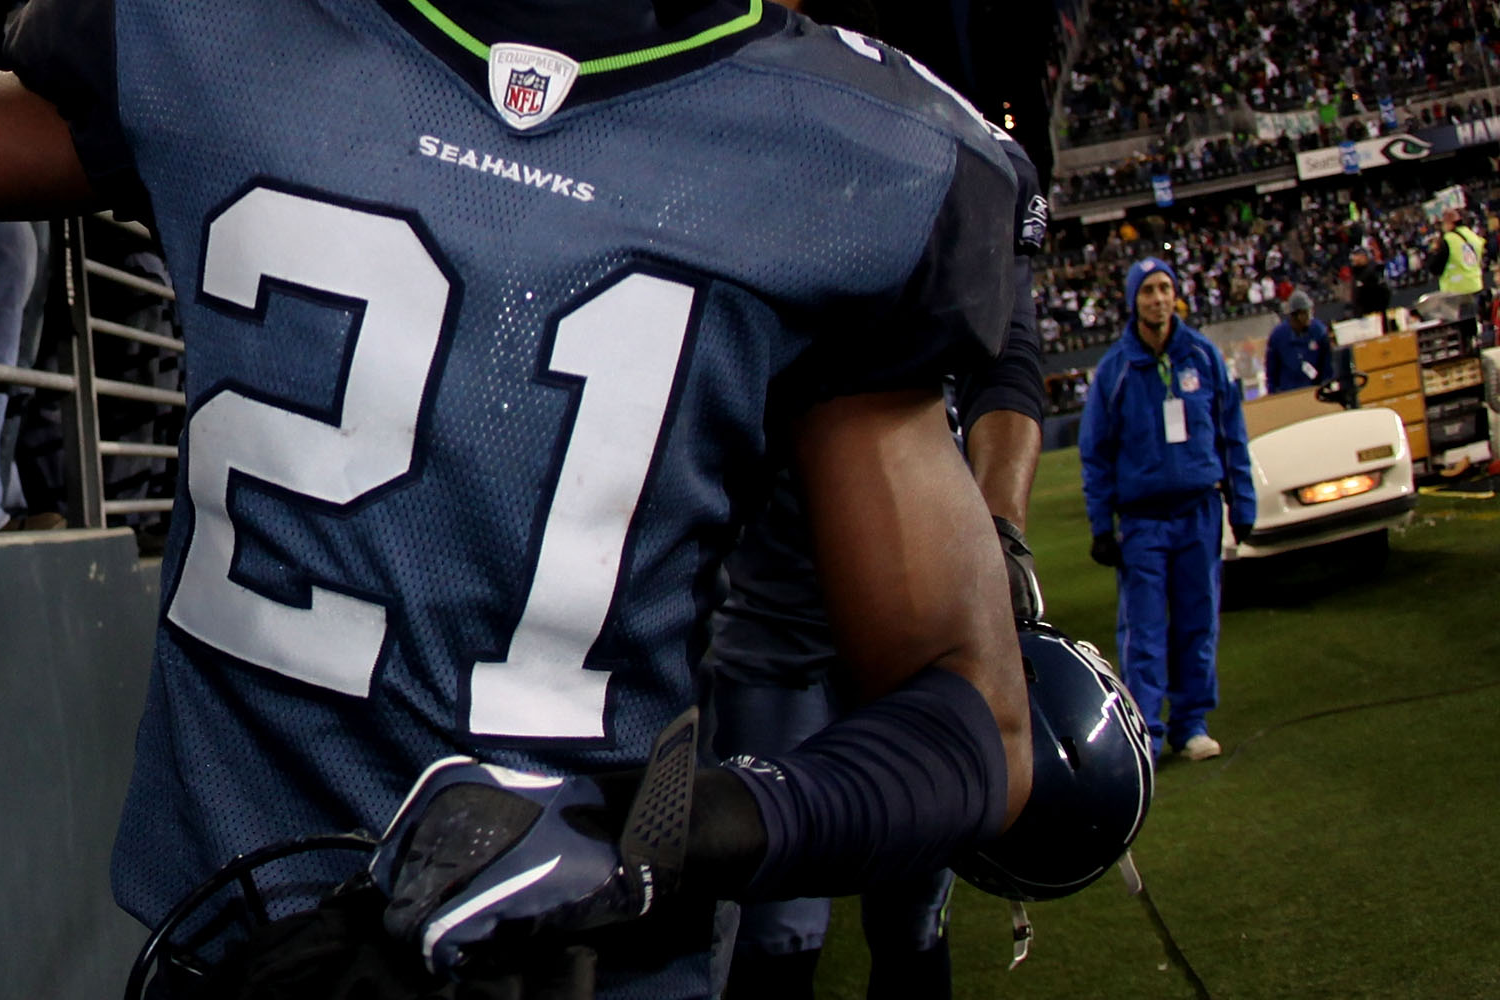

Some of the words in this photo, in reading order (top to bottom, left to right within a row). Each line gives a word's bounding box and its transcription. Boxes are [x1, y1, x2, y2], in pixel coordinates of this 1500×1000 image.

[497, 51, 570, 77] EQUIPMENT
[507, 87, 540, 113] NFL
[419, 135, 595, 202] SEAHAWKS
[166, 186, 697, 738] 21
